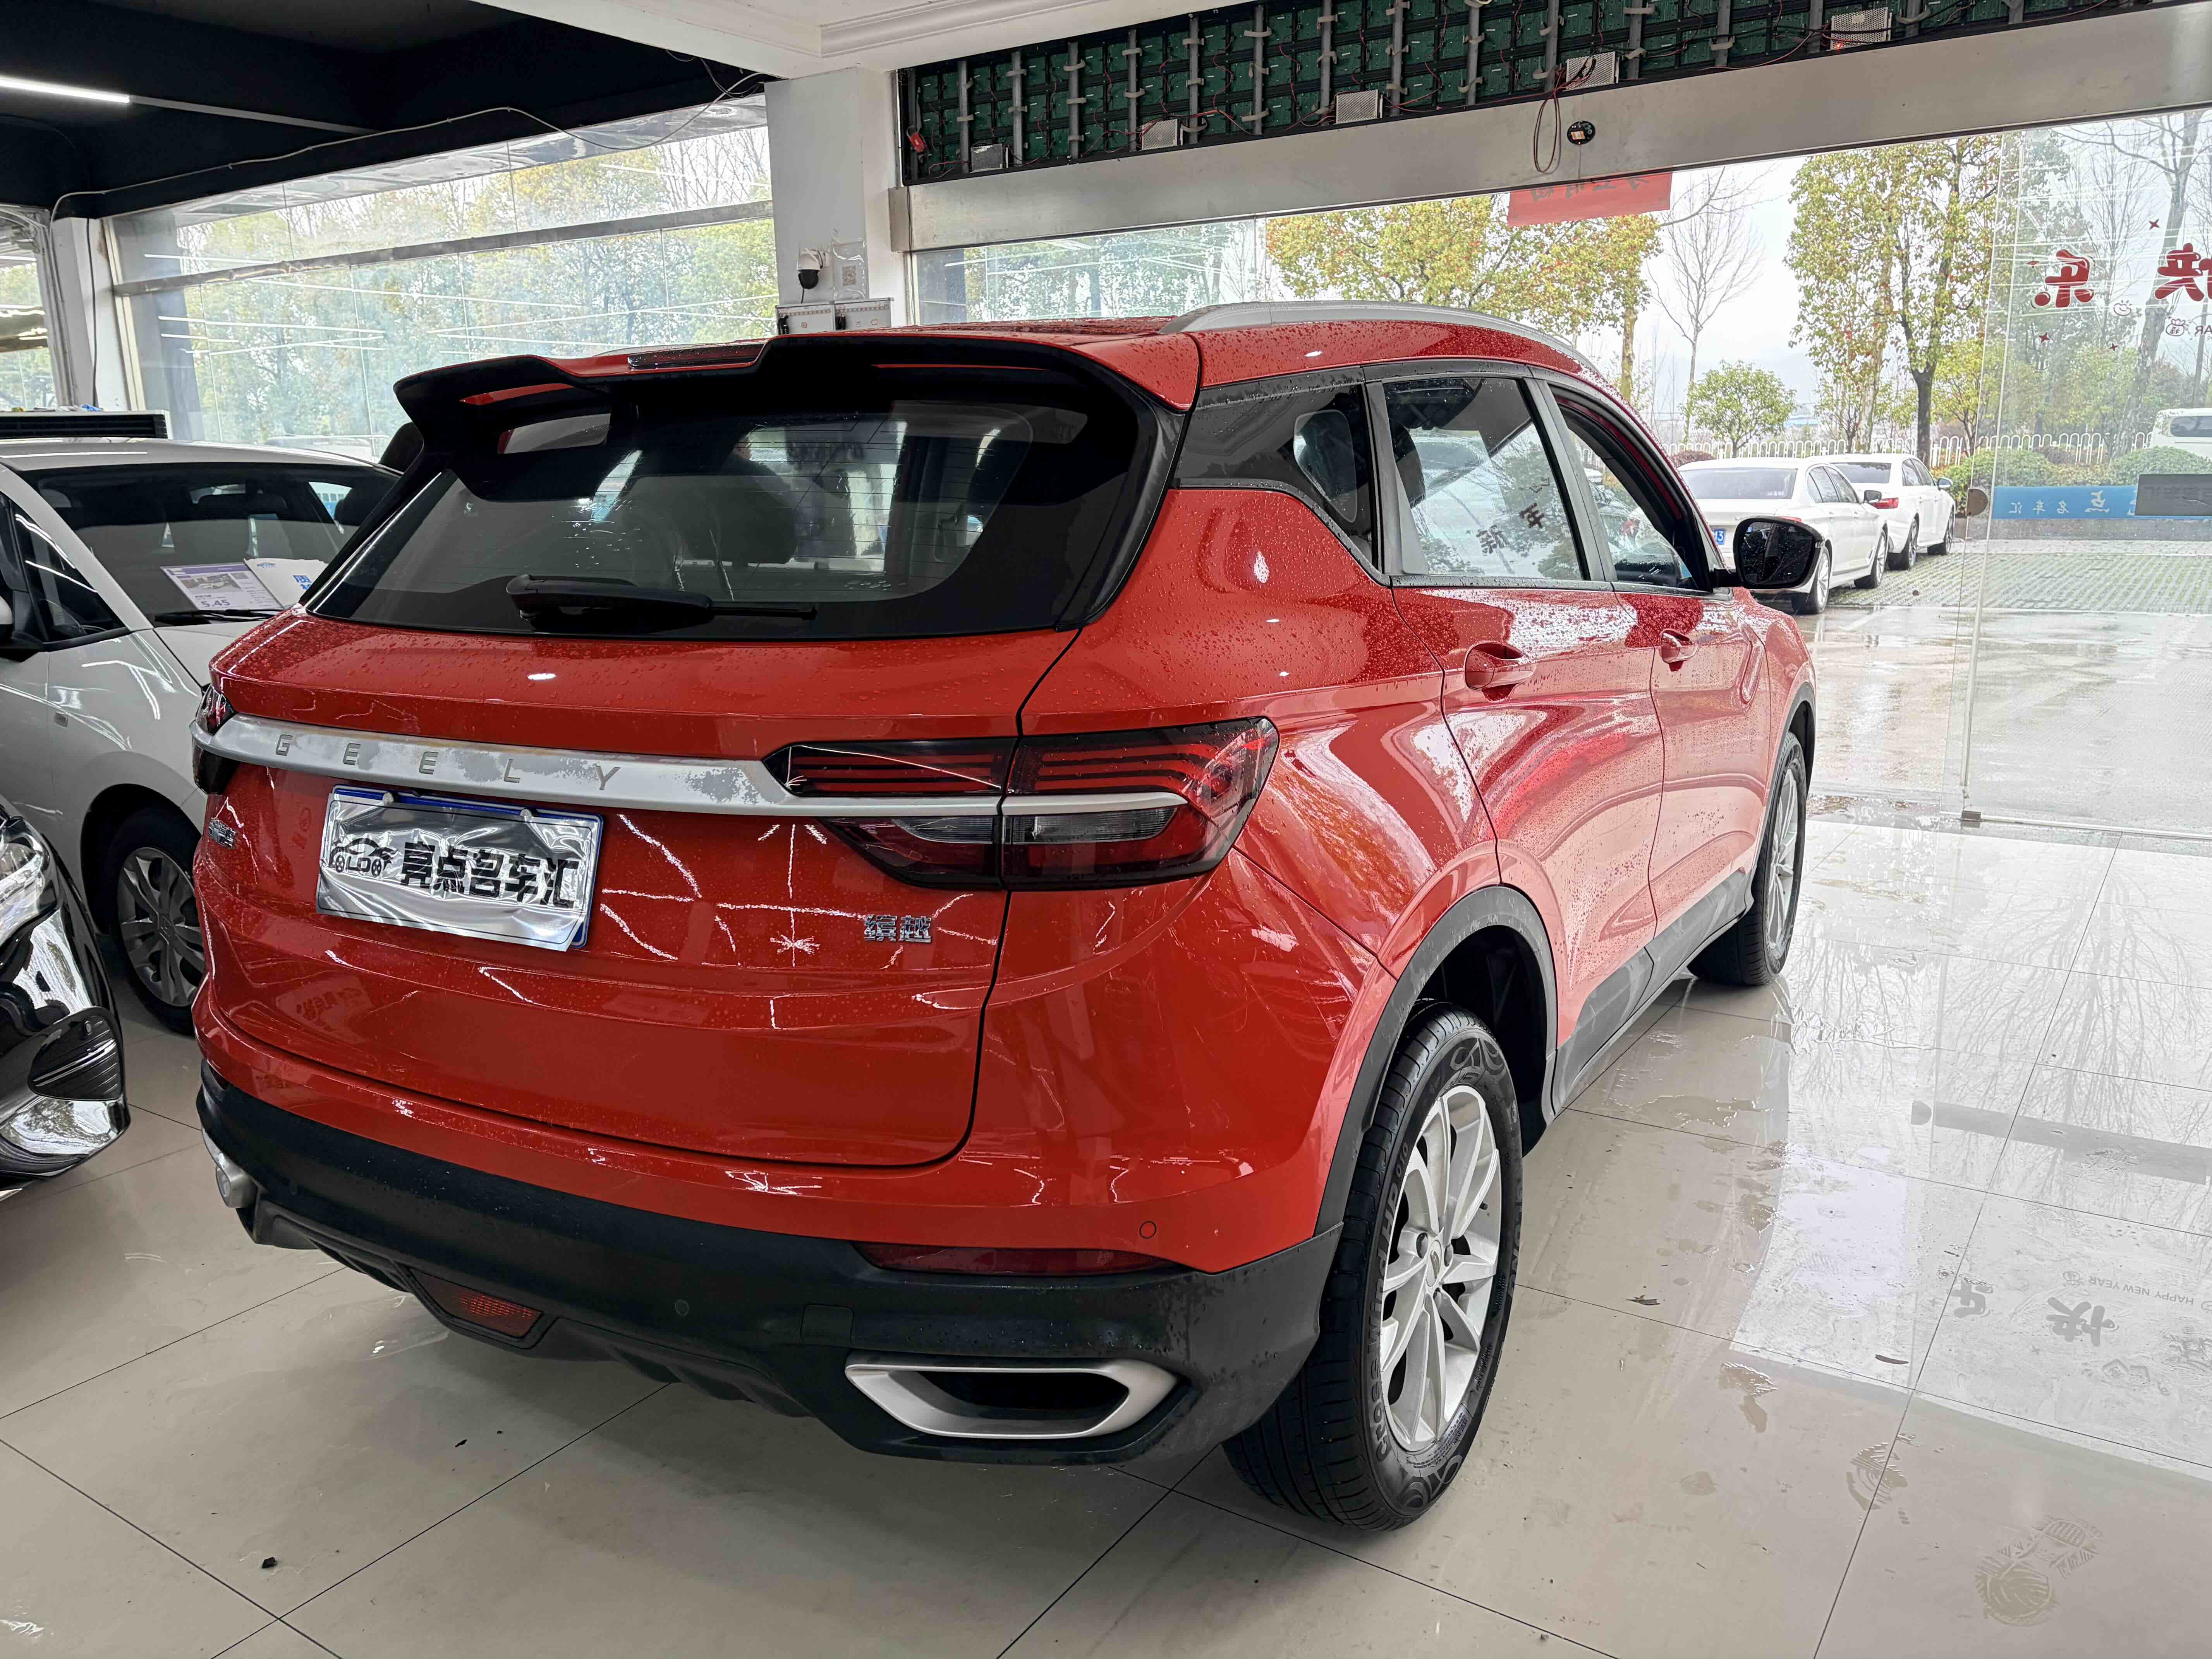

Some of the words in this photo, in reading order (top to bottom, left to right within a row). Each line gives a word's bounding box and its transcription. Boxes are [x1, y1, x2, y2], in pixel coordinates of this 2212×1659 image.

[201, 599, 231, 607] 5.45
[275, 733, 621, 791] GEELY
[400, 842, 579, 908] 亮点名车汇
[864, 914, 933, 943] 缤越
[2088, 1276, 2119, 1290] YEAR
[2123, 1284, 2150, 1296] NEW
[2155, 1291, 2194, 1305] HAPPY
